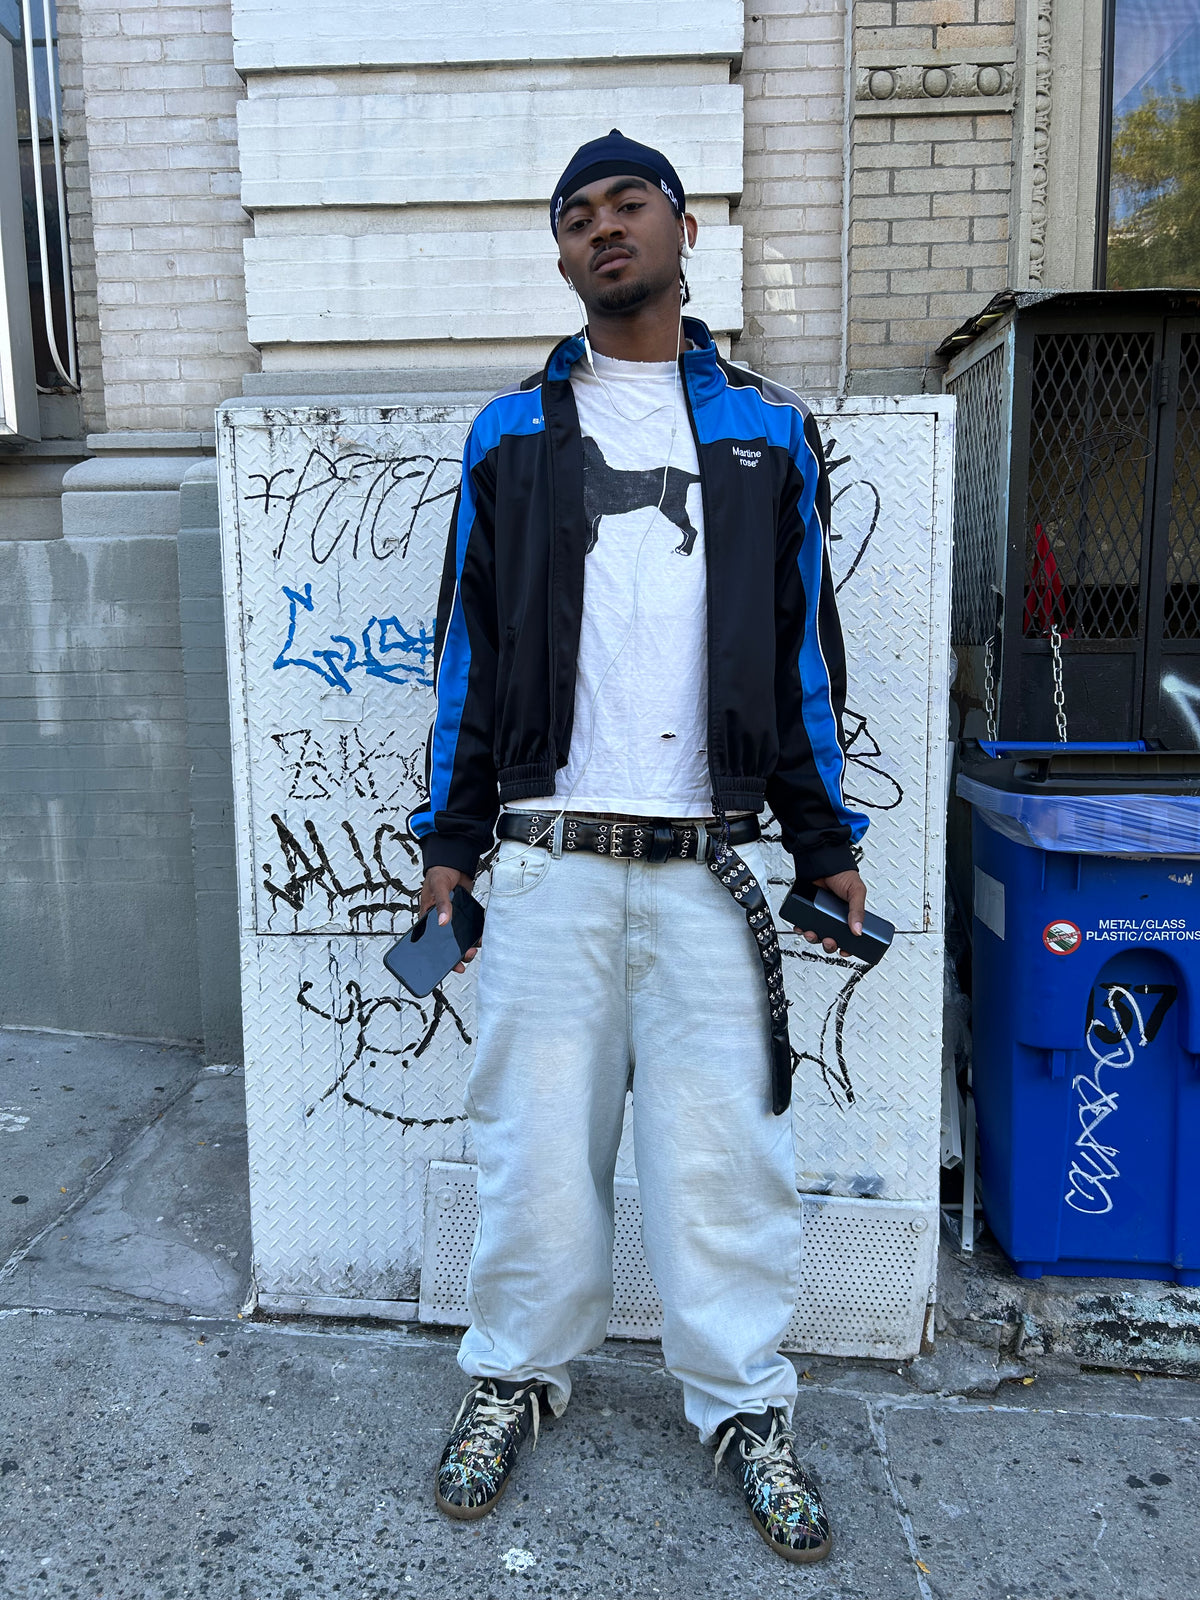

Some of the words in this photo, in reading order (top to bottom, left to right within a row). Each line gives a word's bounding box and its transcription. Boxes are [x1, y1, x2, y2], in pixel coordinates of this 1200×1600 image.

[732, 446, 762, 458] Martine
[1098, 919, 1186, 930] METAL/GLASS
[1086, 930, 1200, 941] PLASTIC/CARTONS
